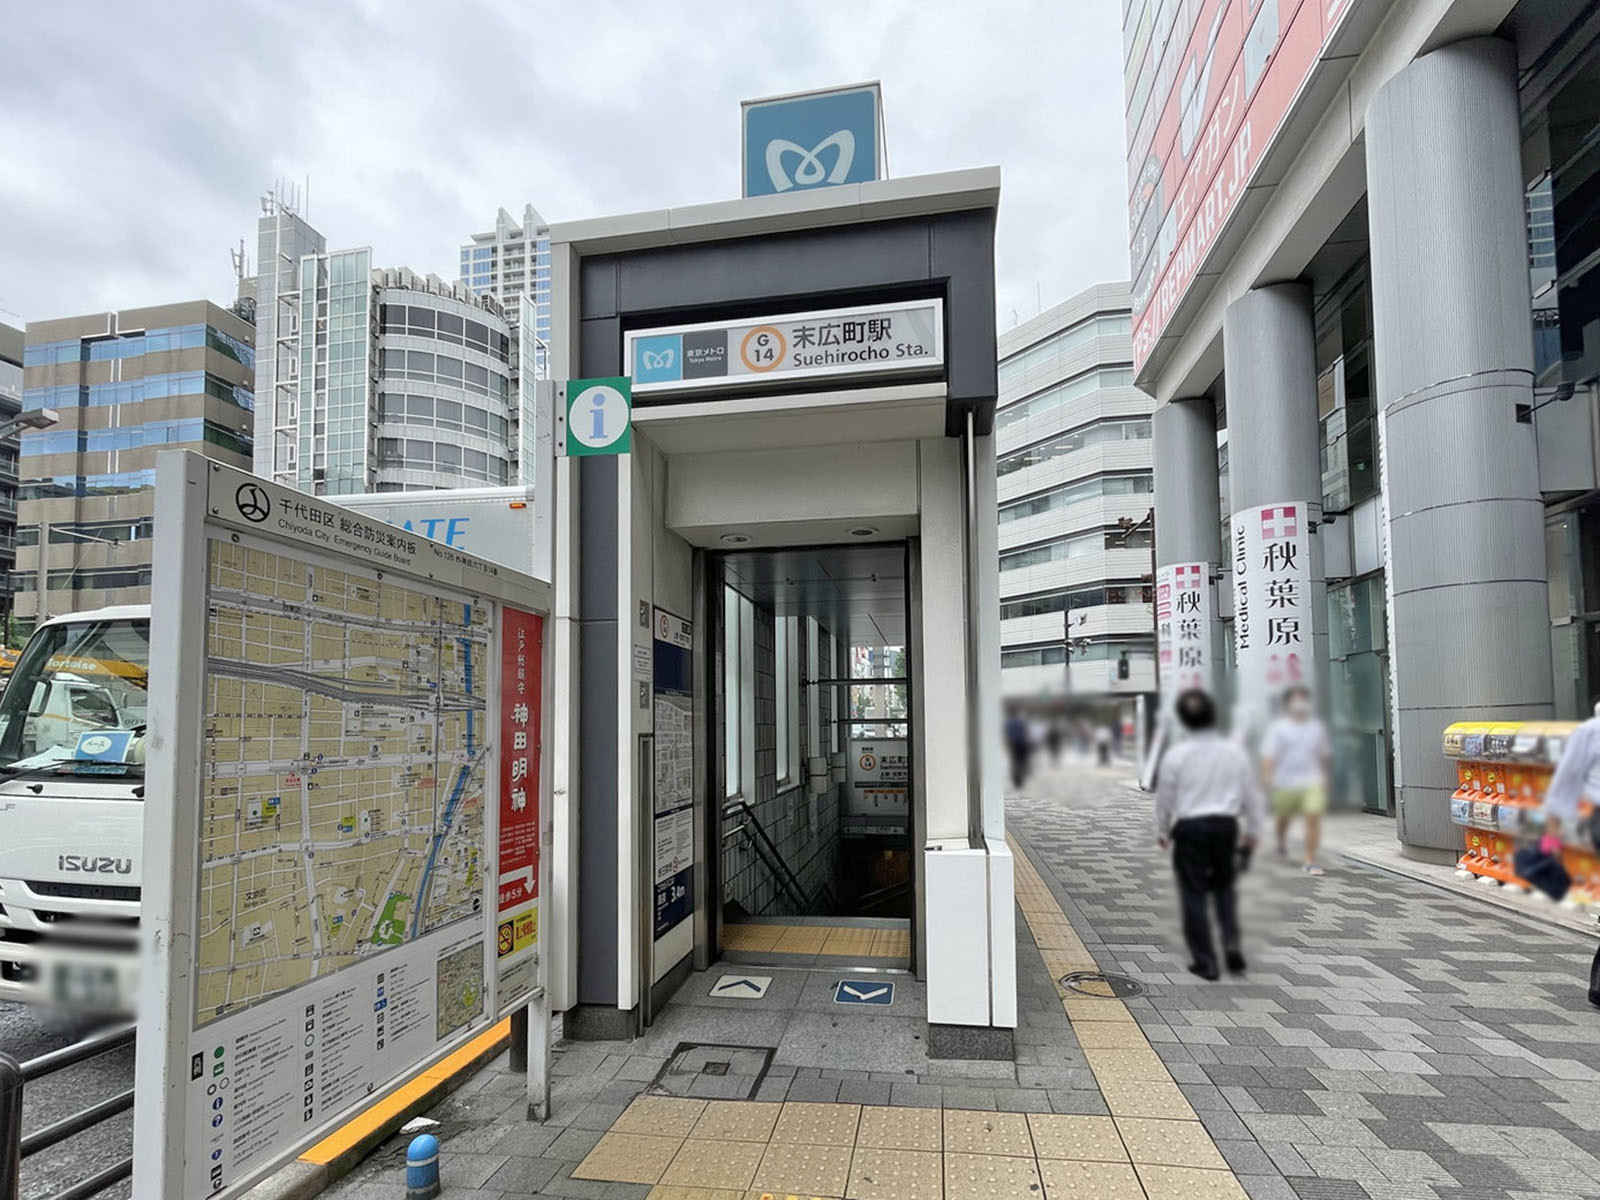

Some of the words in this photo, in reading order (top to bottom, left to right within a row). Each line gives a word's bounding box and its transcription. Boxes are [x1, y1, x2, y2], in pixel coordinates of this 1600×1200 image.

[687, 346, 724, 358] 東京メトロ
[754, 348, 774, 362] 14
[757, 334, 769, 347] G
[792, 318, 891, 349] 末広町駅
[793, 346, 889, 367] Suehirocho
[896, 343, 929, 358] Sta.
[278, 518, 313, 537] Chiyoda
[314, 529, 330, 544] City
[334, 534, 373, 555] Emergency
[374, 547, 392, 560] Guide
[393, 553, 412, 566] Board
[279, 499, 336, 528] 千代田区
[340, 517, 417, 556] 総合防災案内板
[1236, 524, 1247, 575] Clinic
[1237, 580, 1250, 649] Medical
[1262, 541, 1302, 647] 秋葉原
[1176, 590, 1203, 669] 秋葉原
[511, 703, 529, 814] 神田明神
[58, 855, 132, 875] ISUZU
